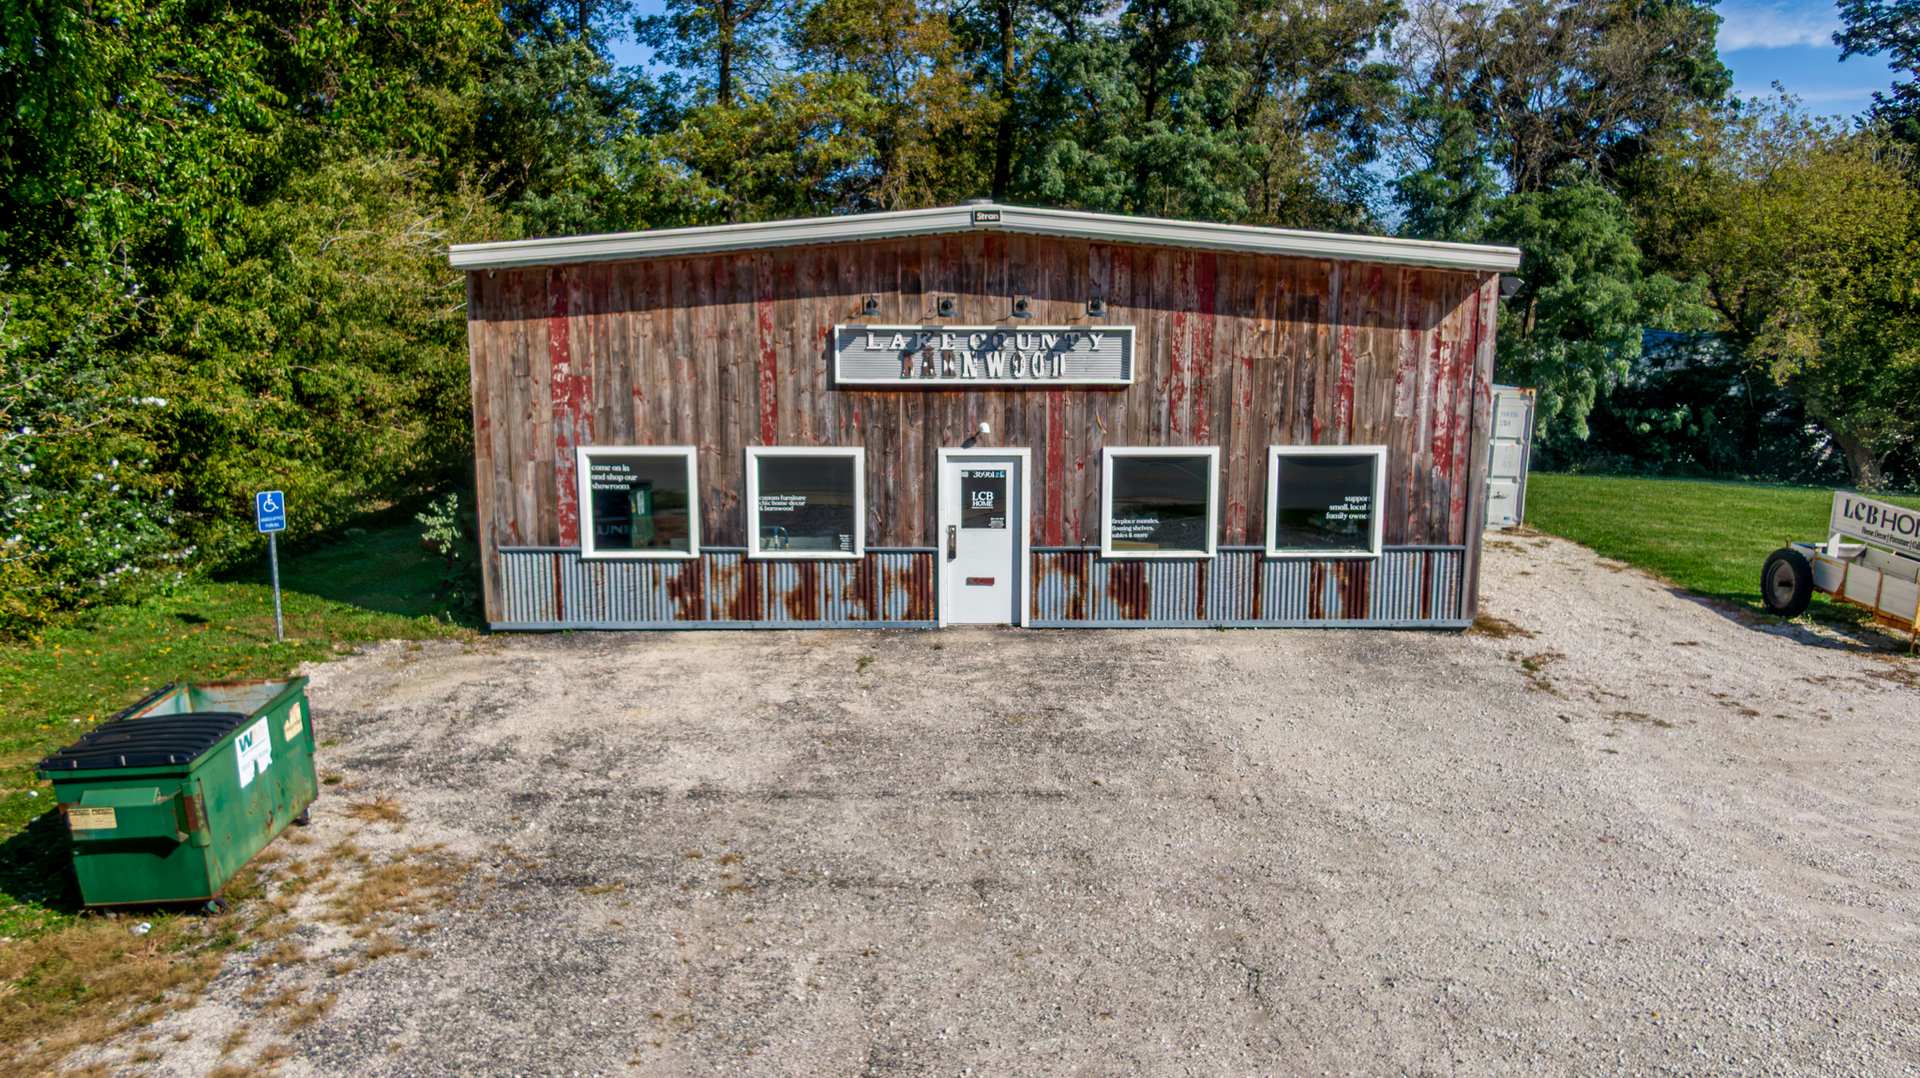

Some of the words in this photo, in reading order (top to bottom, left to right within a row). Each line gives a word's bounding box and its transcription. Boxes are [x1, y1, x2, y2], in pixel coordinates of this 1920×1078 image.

[976, 211, 999, 220] Stran
[865, 331, 957, 350] LAKE
[968, 331, 1106, 350] COUNTY
[901, 346, 1068, 378] BARNWOOD
[622, 463, 631, 472] in
[591, 472, 606, 481] and
[606, 472, 624, 483] shop
[591, 481, 631, 490] showroom
[971, 490, 994, 501] LCB
[1350, 503, 1367, 511] local
[1325, 511, 1348, 520] family
[1843, 498, 1879, 525] LCB
[1880, 509, 1920, 538] HO
[1861, 526, 1875, 537] Home
